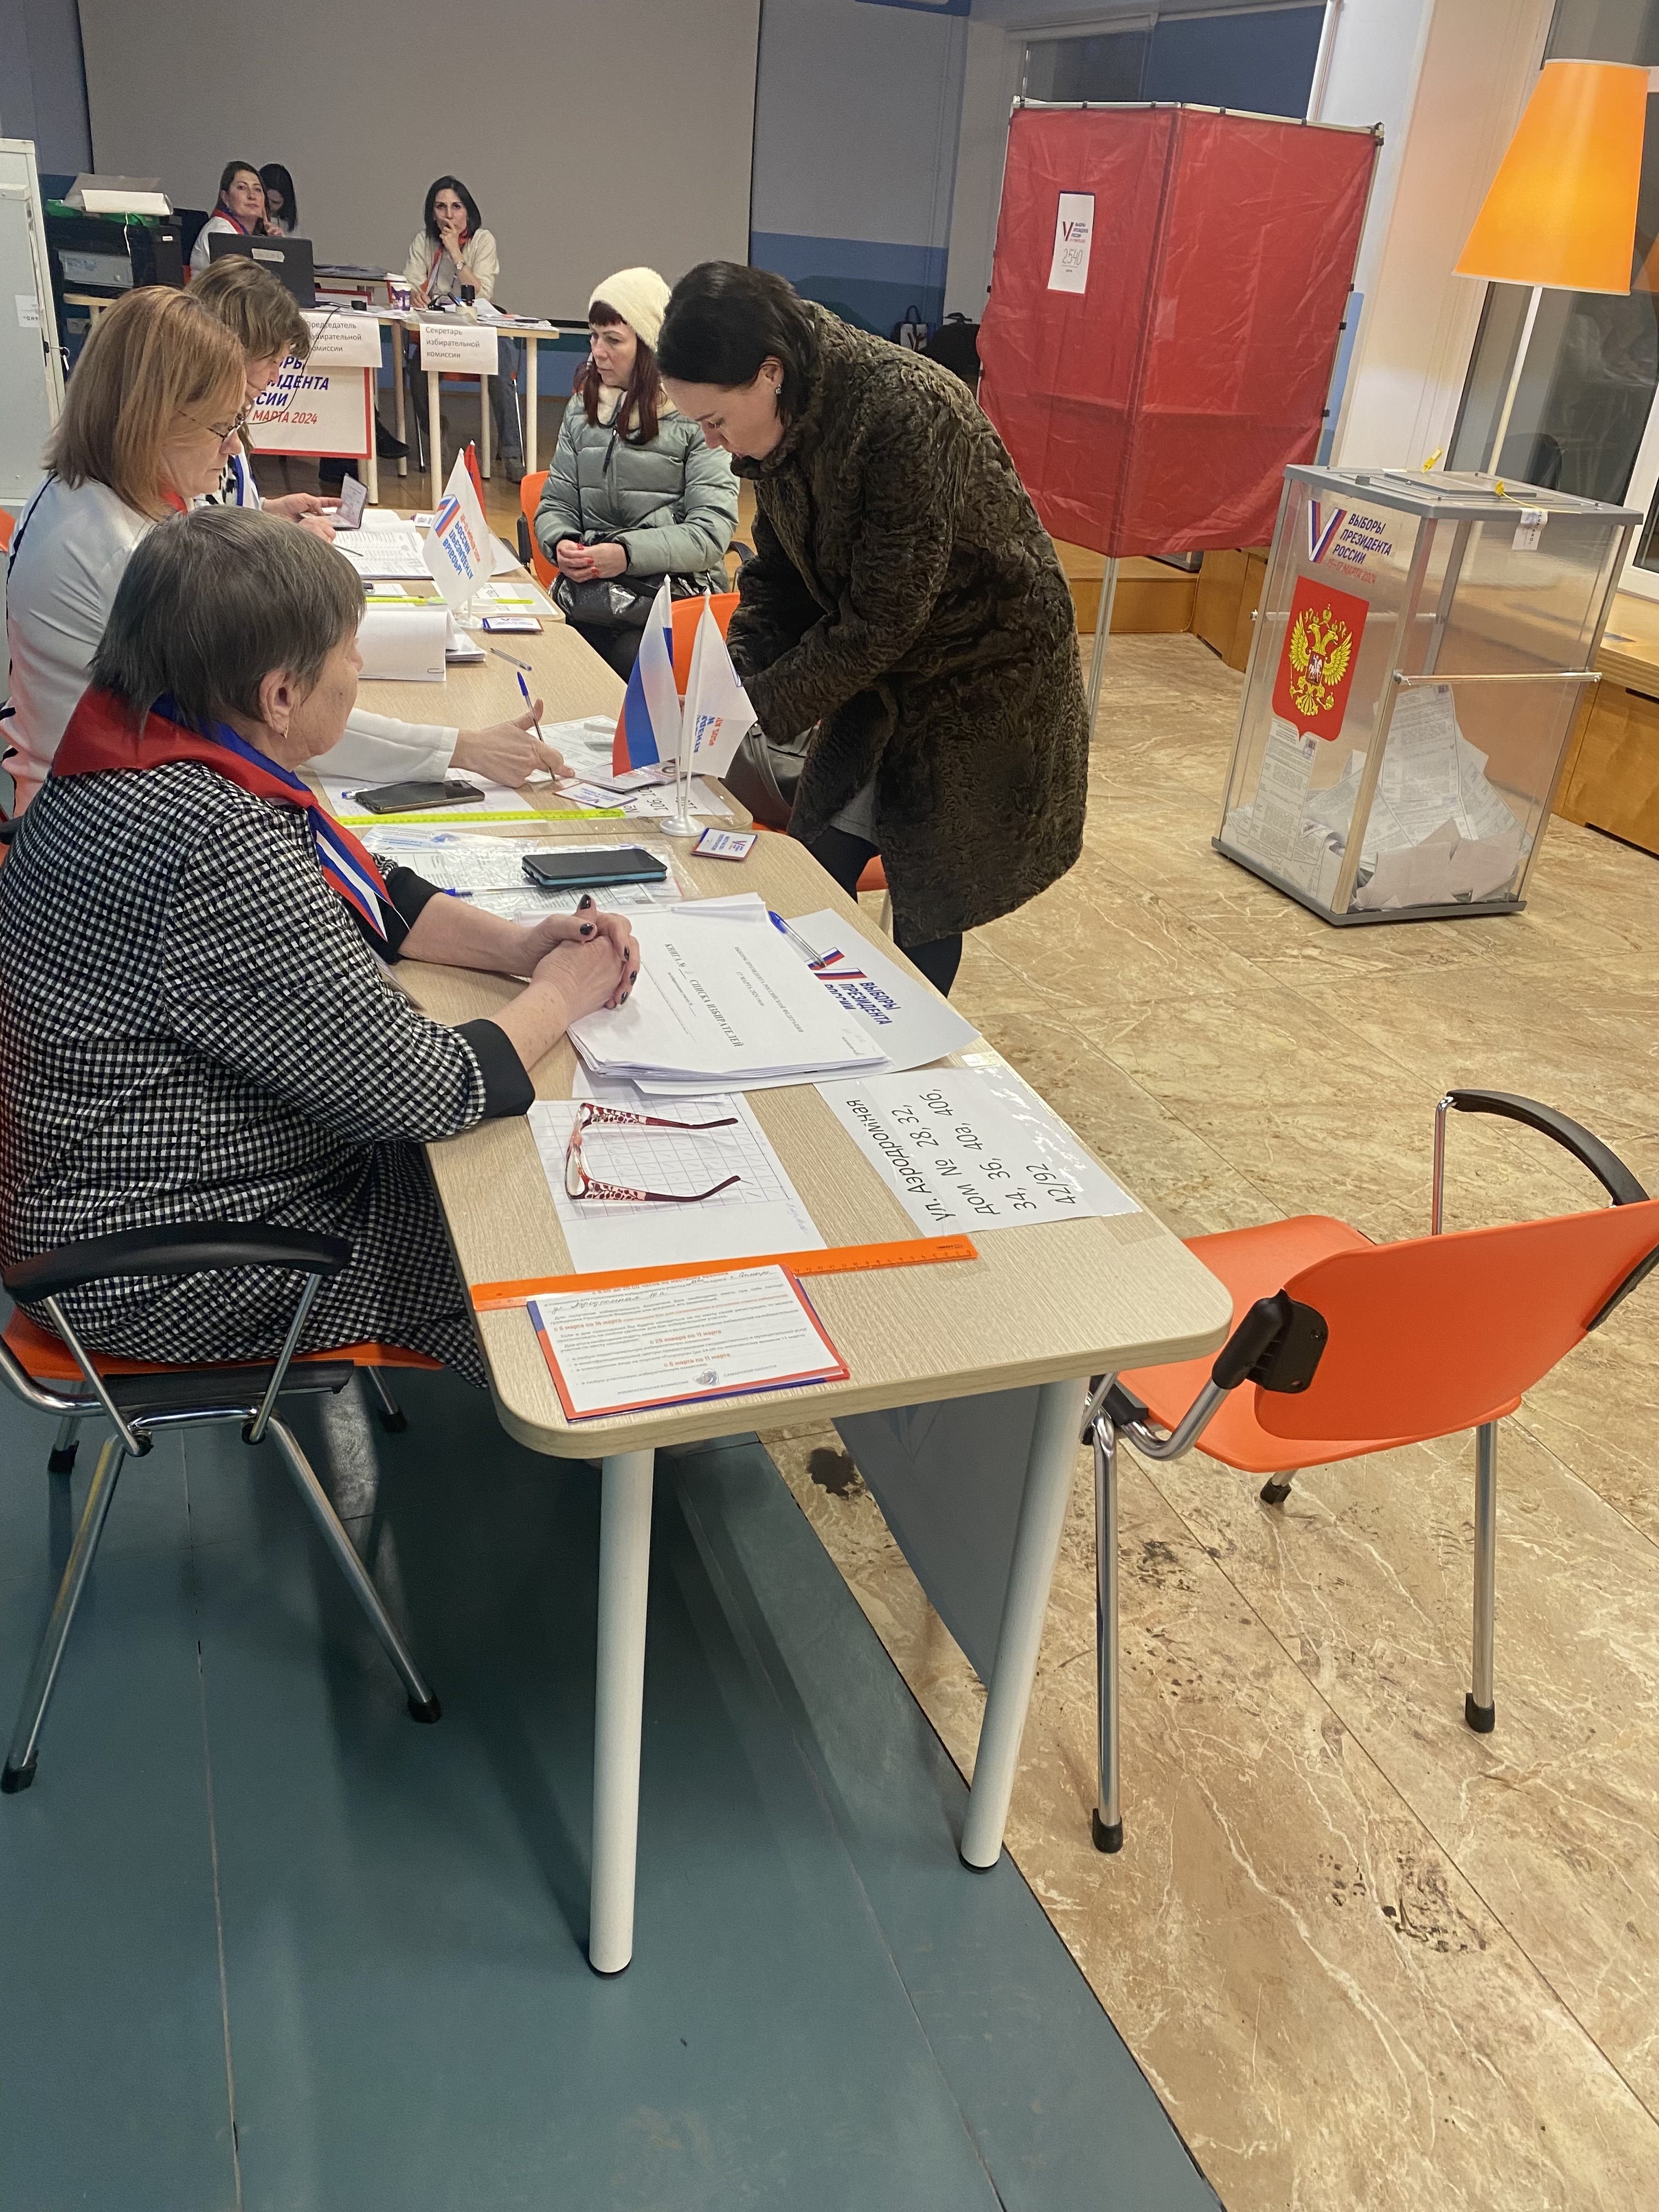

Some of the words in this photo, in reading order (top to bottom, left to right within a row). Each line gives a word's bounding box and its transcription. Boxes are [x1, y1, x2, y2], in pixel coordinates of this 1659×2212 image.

[426, 326, 462, 336] Секретарь
[426, 338, 480, 347] избирательной
[253, 410, 289, 422] МАРТА
[291, 412, 318, 424] 2024
[1348, 514, 1386, 535] ВЫБОРЫ
[1340, 528, 1392, 556] ПРЕЗИДЕНТА
[1332, 544, 1367, 564] РОССИИ
[1342, 565, 1362, 579] МАРТА
[1362, 571, 1377, 584] 2024
[636, 787, 656, 797] 10
[646, 798, 668, 811] 106,
[664, 944, 682, 962] КНИГА
[690, 979, 711, 1003] СПИСКА
[706, 1004, 744, 1047] ИЗБИРАТЕЛЕЙ
[746, 961, 765, 983] ПРЕЗИДЕНТА
[763, 984, 786, 1009] РОССИЙСКОЙ
[783, 1009, 804, 1032] ФЕДЕРАЦИИ
[838, 984, 893, 1025] ПРЕЗИДЕНТА
[859, 982, 901, 1010] ВЫБОРЫ
[891, 1105, 919, 1124] 32,
[846, 1099, 932, 1193] Аэродромная
[909, 1127, 939, 1147] 28,
[955, 1122, 983, 1150] 40а,
[935, 1159, 962, 1176] №
[979, 1158, 1011, 1180] 36,
[1026, 1163, 1076, 1204] 42/92
[925, 1198, 956, 1221] ул.
[957, 1184, 1001, 1215] дом
[1005, 1188, 1037, 1210] 34,
[711, 1352, 730, 1361] марта
